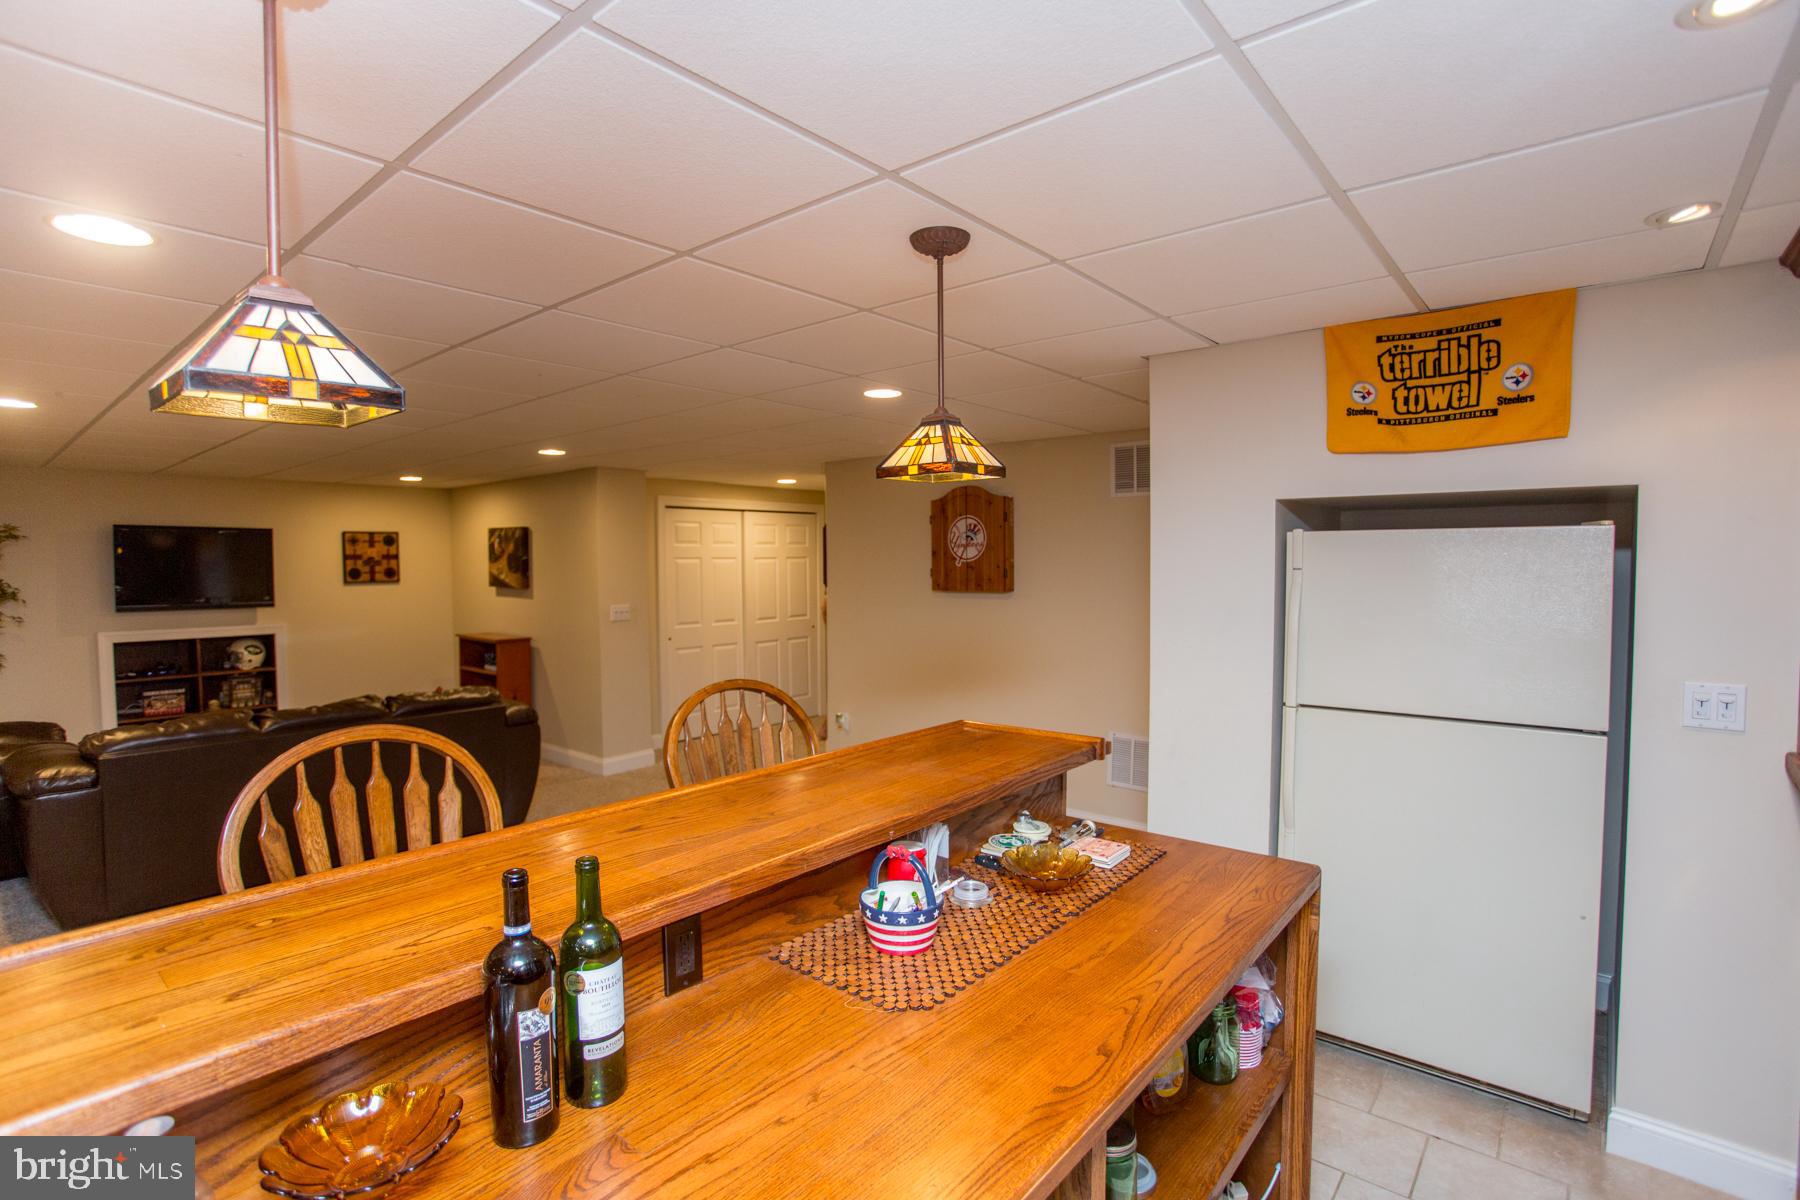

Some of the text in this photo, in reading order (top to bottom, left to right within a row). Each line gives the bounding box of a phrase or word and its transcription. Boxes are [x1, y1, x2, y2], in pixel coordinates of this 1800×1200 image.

[1393, 344, 1414, 352] The
[1377, 333, 1501, 383] terrible
[1392, 370, 1482, 416] towel
[1497, 394, 1535, 406] Steelers
[1346, 406, 1378, 416] Steelers
[1390, 415, 1446, 425] PITTSBURGH
[1450, 410, 1493, 420] ORIGINAL
[533, 1038, 543, 1091] AMARANTA
